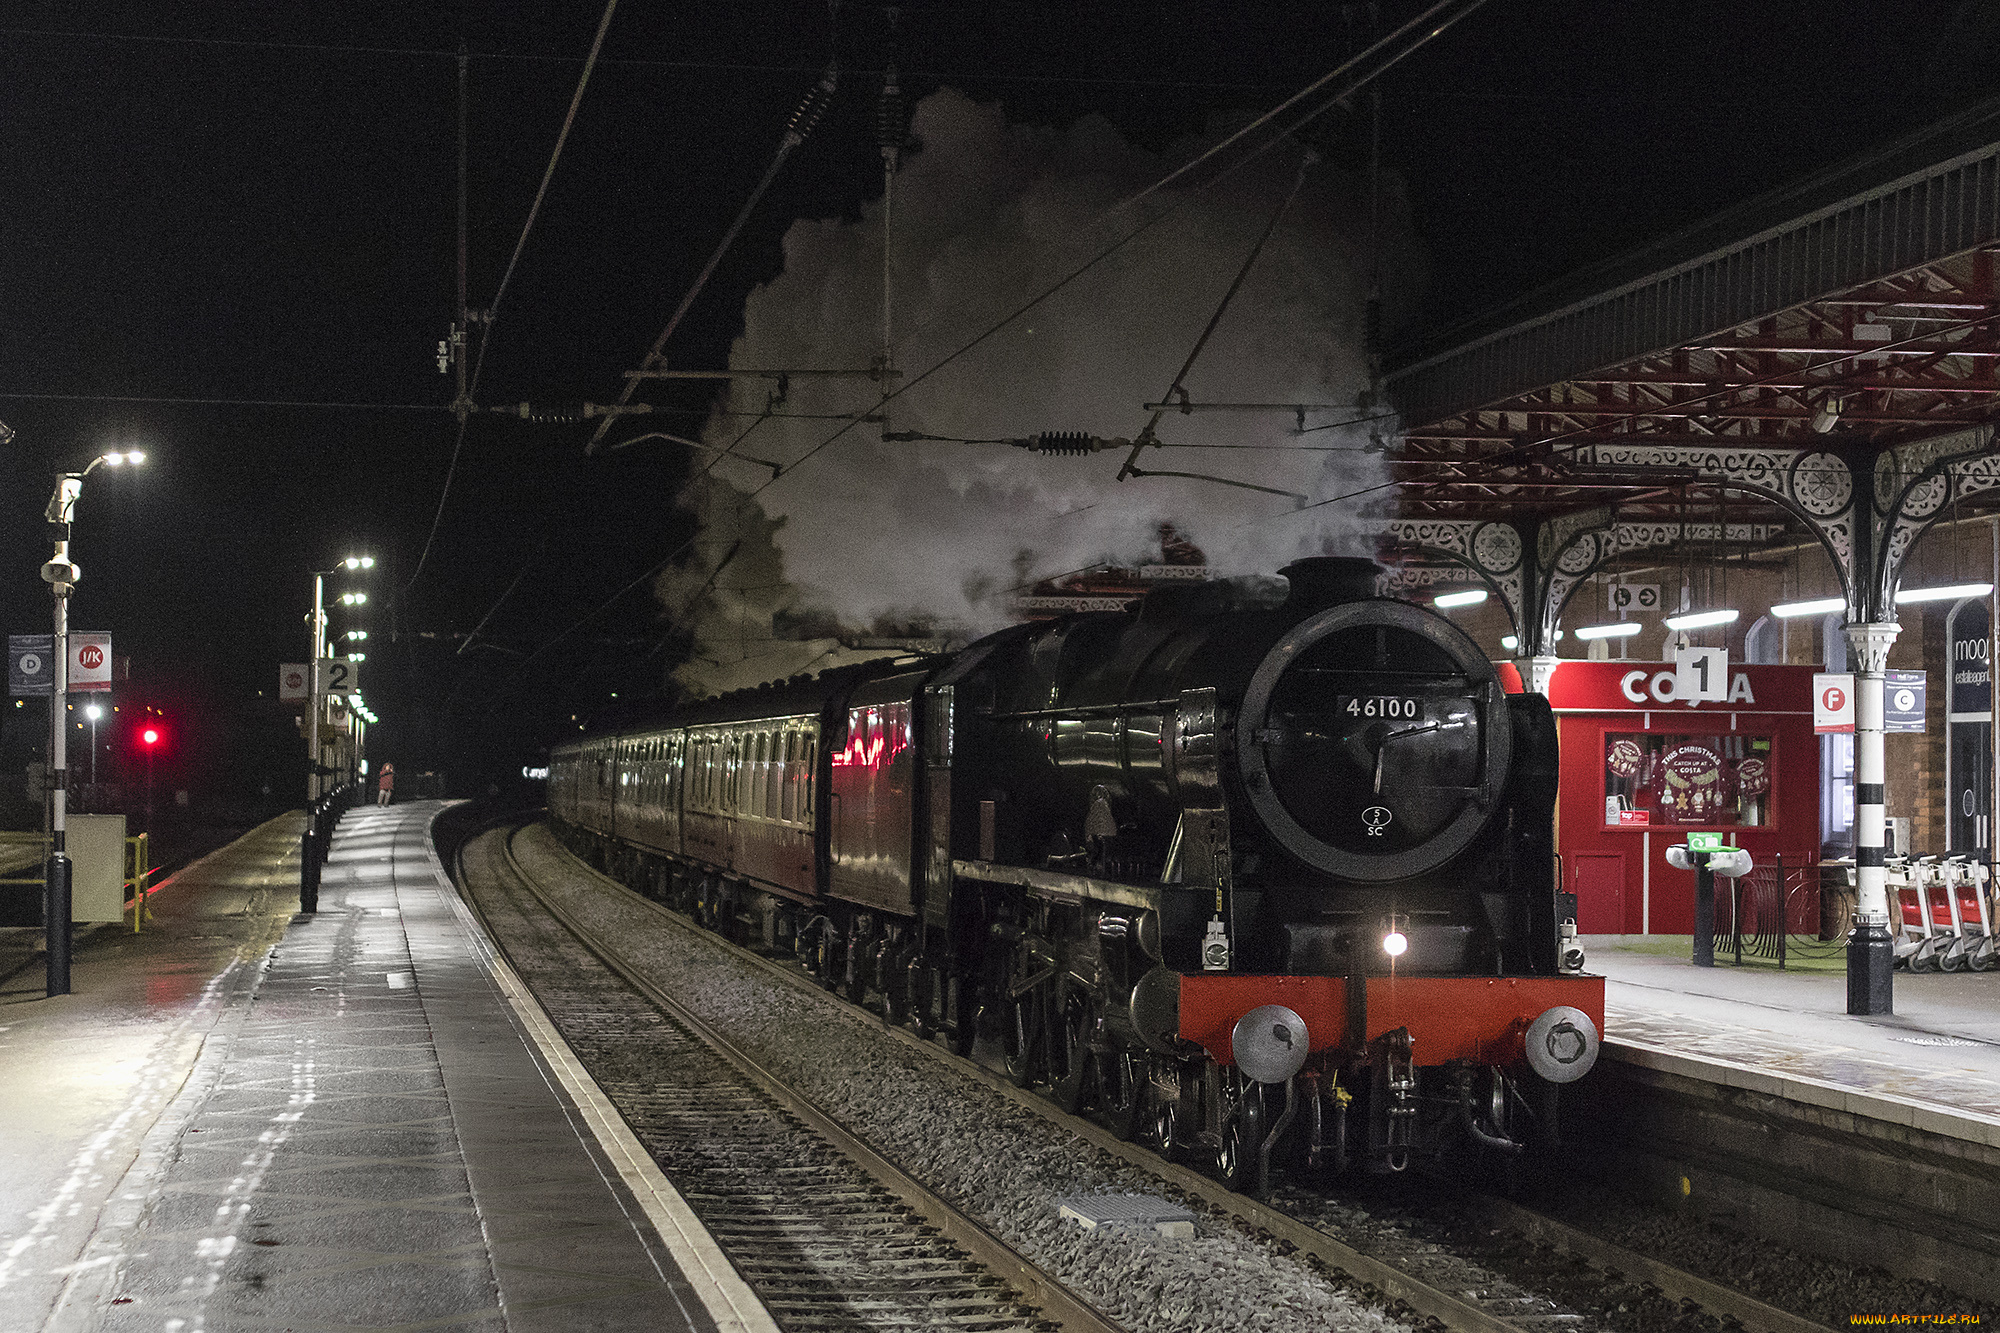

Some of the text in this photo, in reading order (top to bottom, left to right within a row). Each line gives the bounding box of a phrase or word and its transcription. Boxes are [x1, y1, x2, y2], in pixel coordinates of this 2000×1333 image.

[26, 659, 36, 669] D
[82, 651, 101, 665] J/K
[328, 663, 349, 690] 2
[1691, 655, 1709, 692] 1
[1620, 670, 1755, 708] COA
[1828, 690, 1840, 709] F
[1900, 695, 1909, 705] C
[1346, 698, 1416, 718] 46100
[1661, 750, 1679, 765] THIS
[1678, 746, 1722, 766] CHRISTMAS
[1373, 817, 1380, 825] A
[1374, 809, 1381, 818] 5
[1367, 826, 1384, 836] SC
